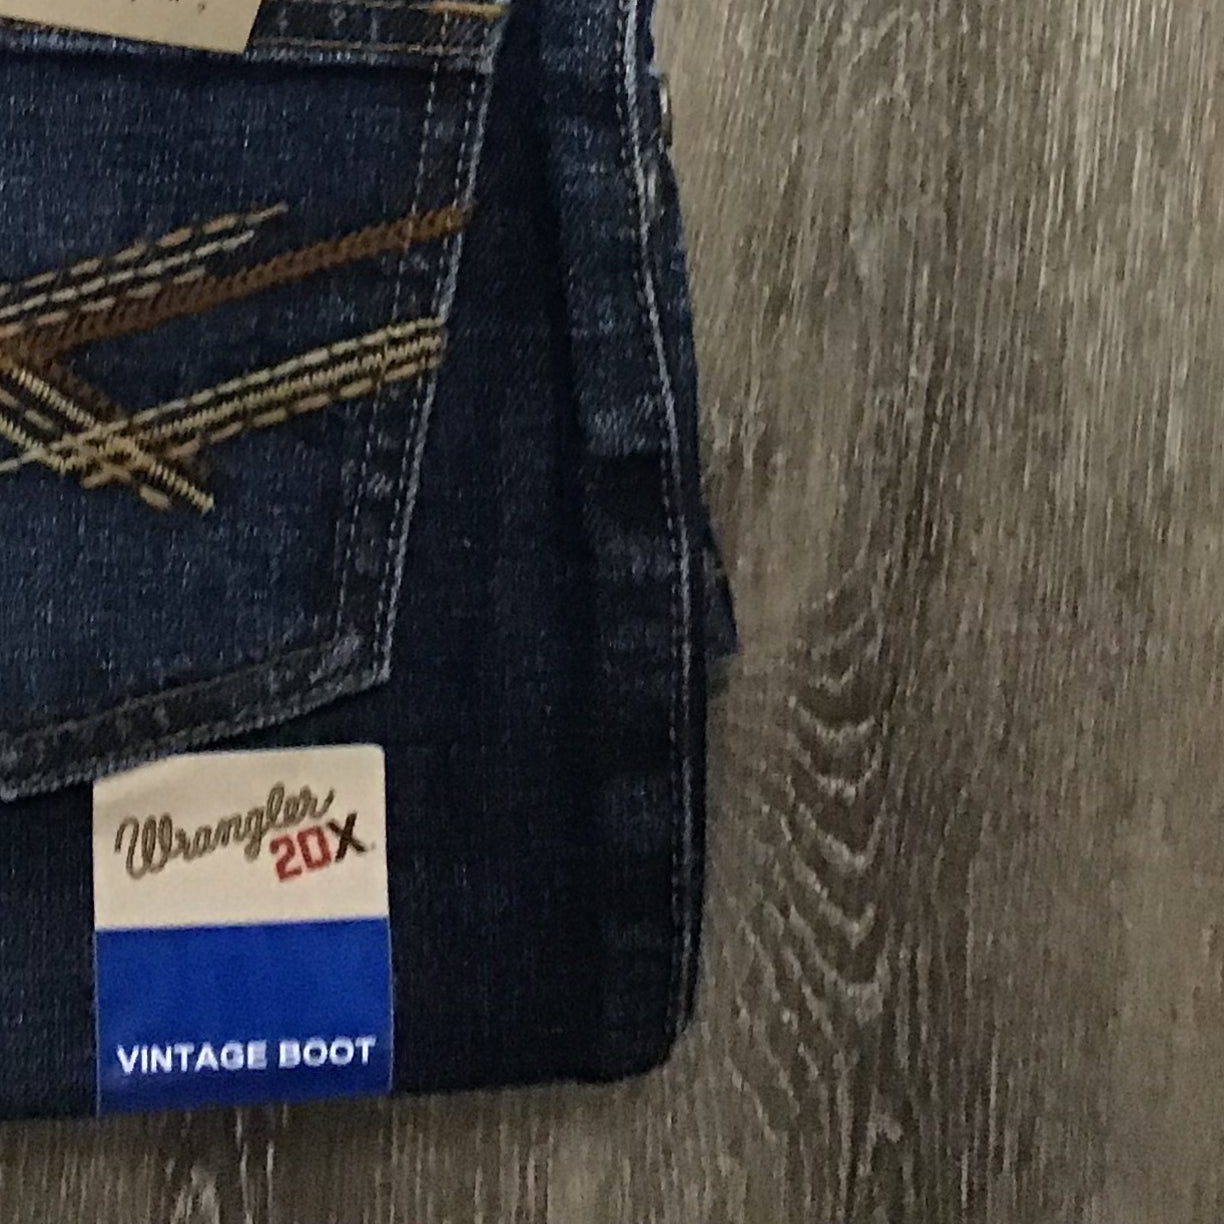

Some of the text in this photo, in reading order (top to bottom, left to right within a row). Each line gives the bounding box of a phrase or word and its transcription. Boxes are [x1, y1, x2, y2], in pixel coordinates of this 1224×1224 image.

[114, 781, 335, 879] Wrangler
[269, 812, 367, 883] 20X
[116, 1034, 377, 1075] VINTAGE BOOT
